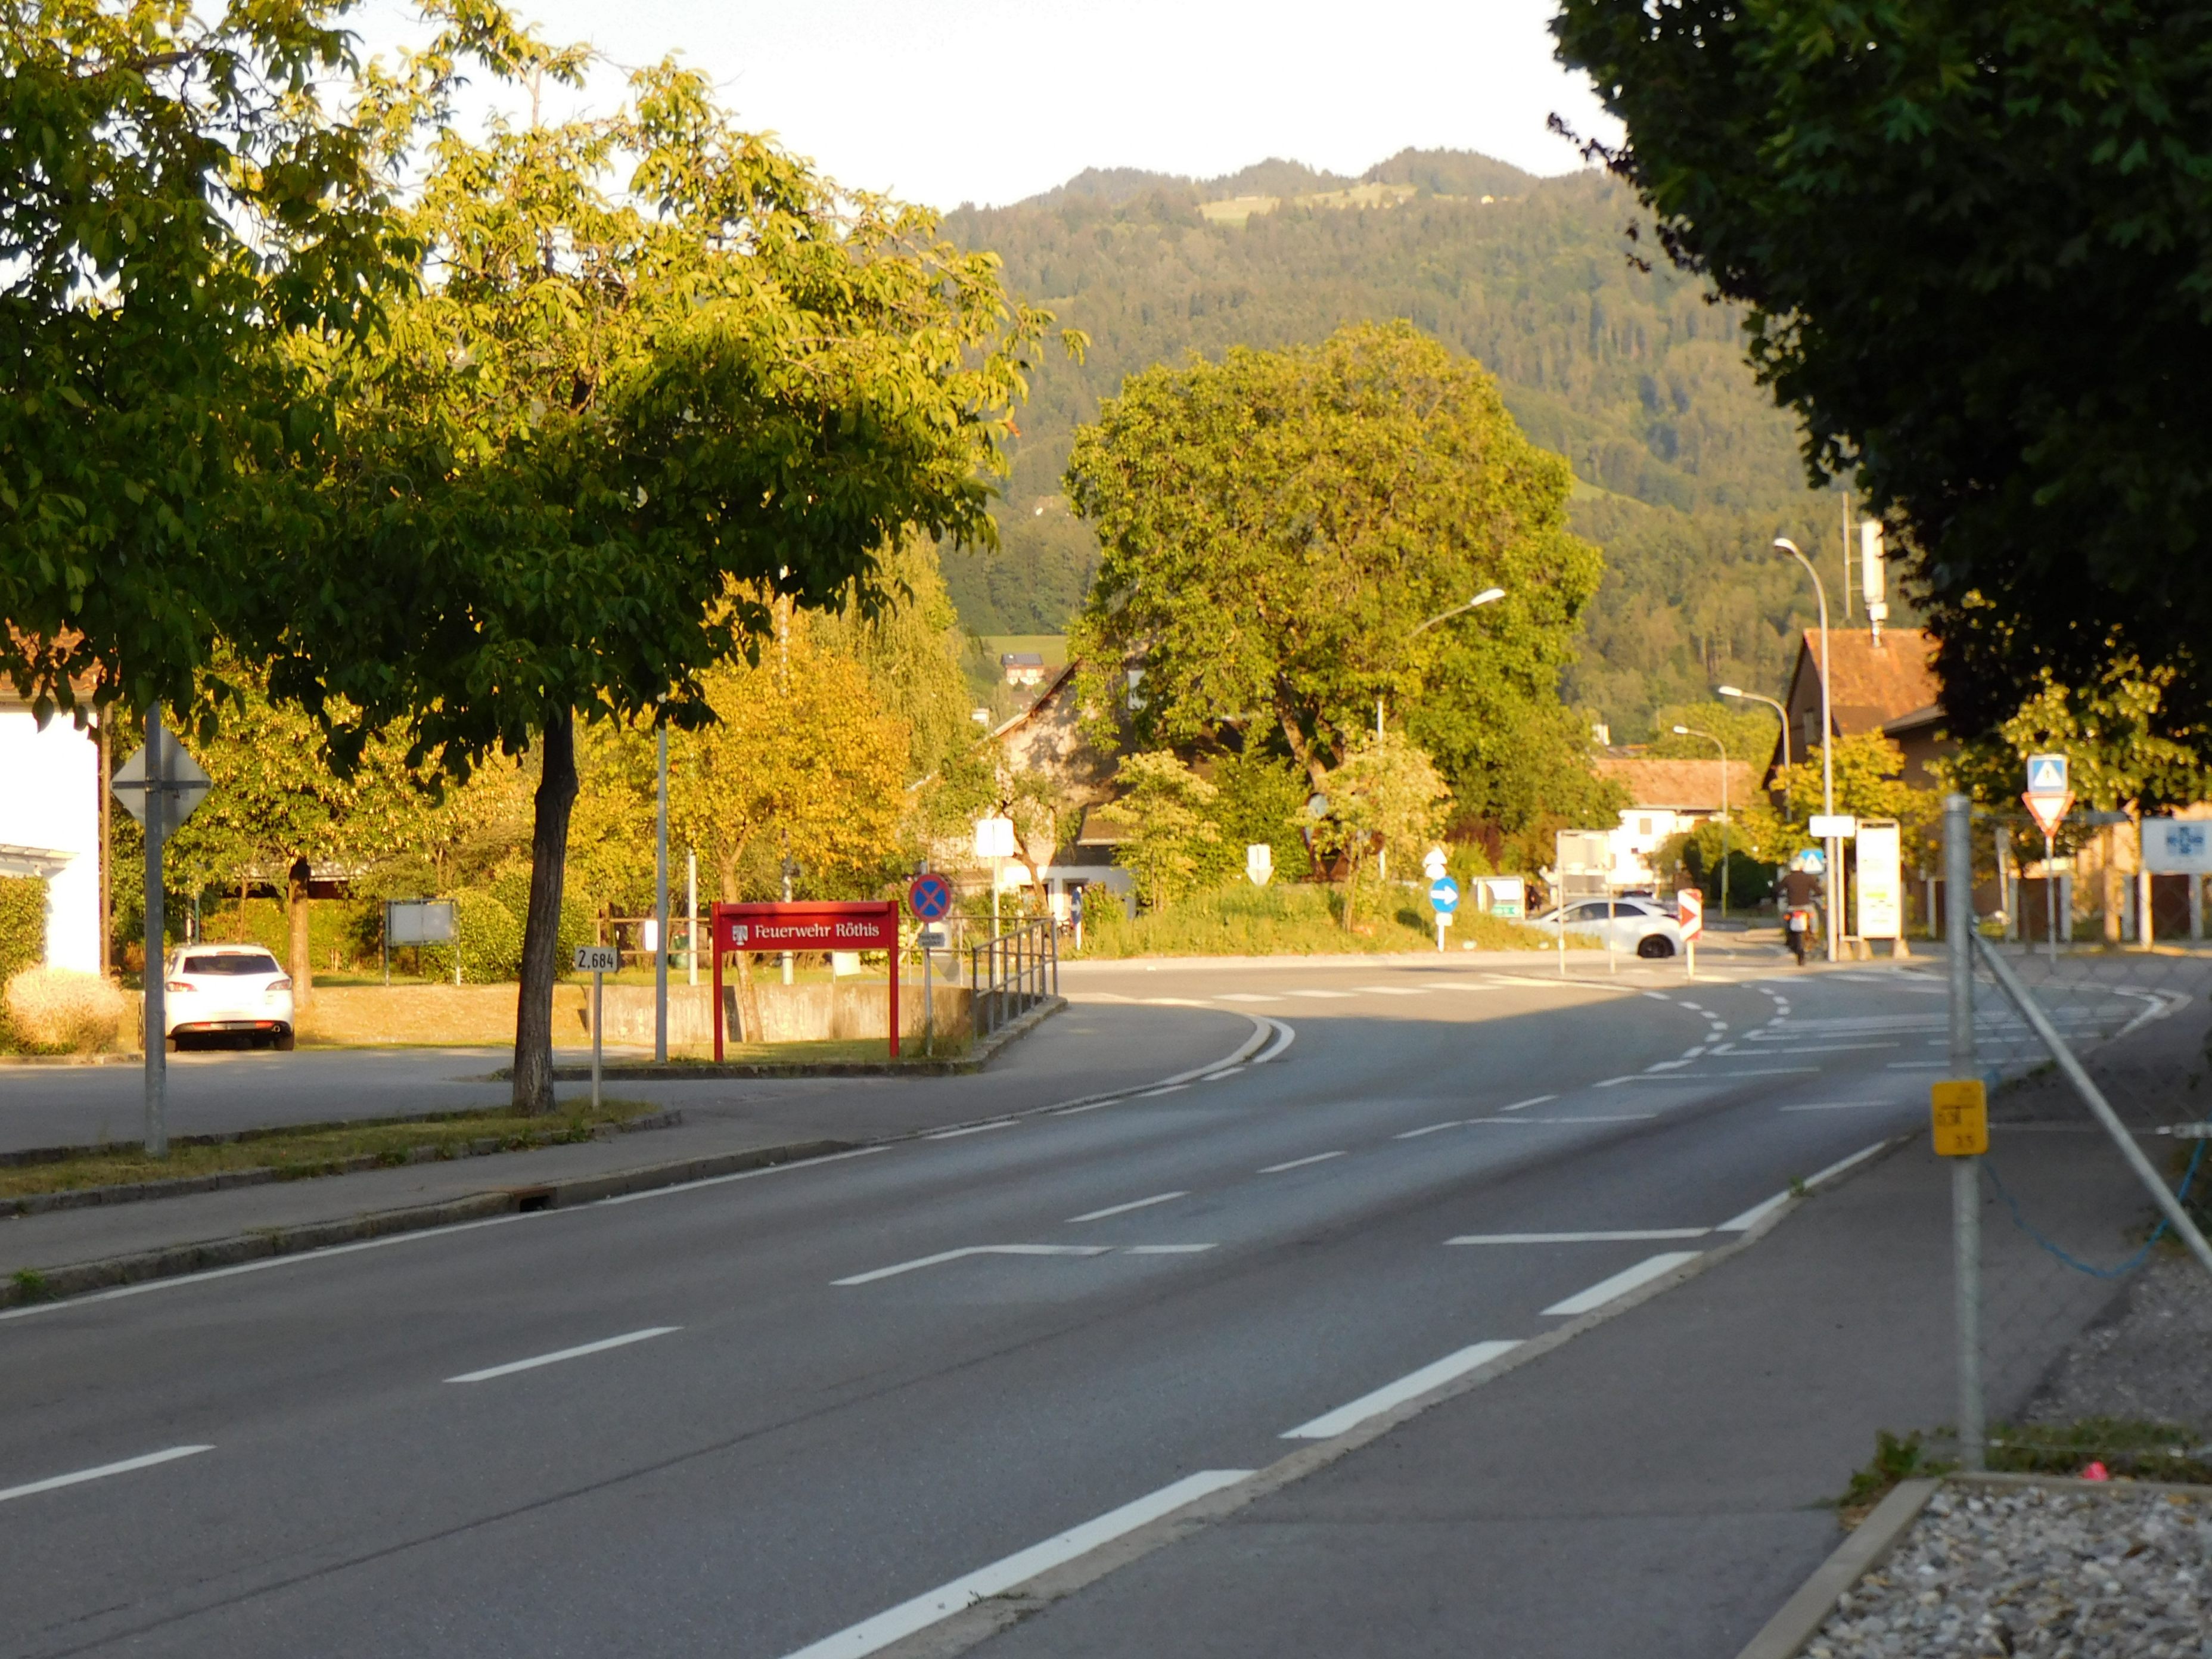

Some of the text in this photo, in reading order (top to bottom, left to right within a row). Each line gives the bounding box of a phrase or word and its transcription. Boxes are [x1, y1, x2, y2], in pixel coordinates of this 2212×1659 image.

[755, 922, 880, 938] Feuerwehr Röthis
[578, 950, 613, 969] 2.684
